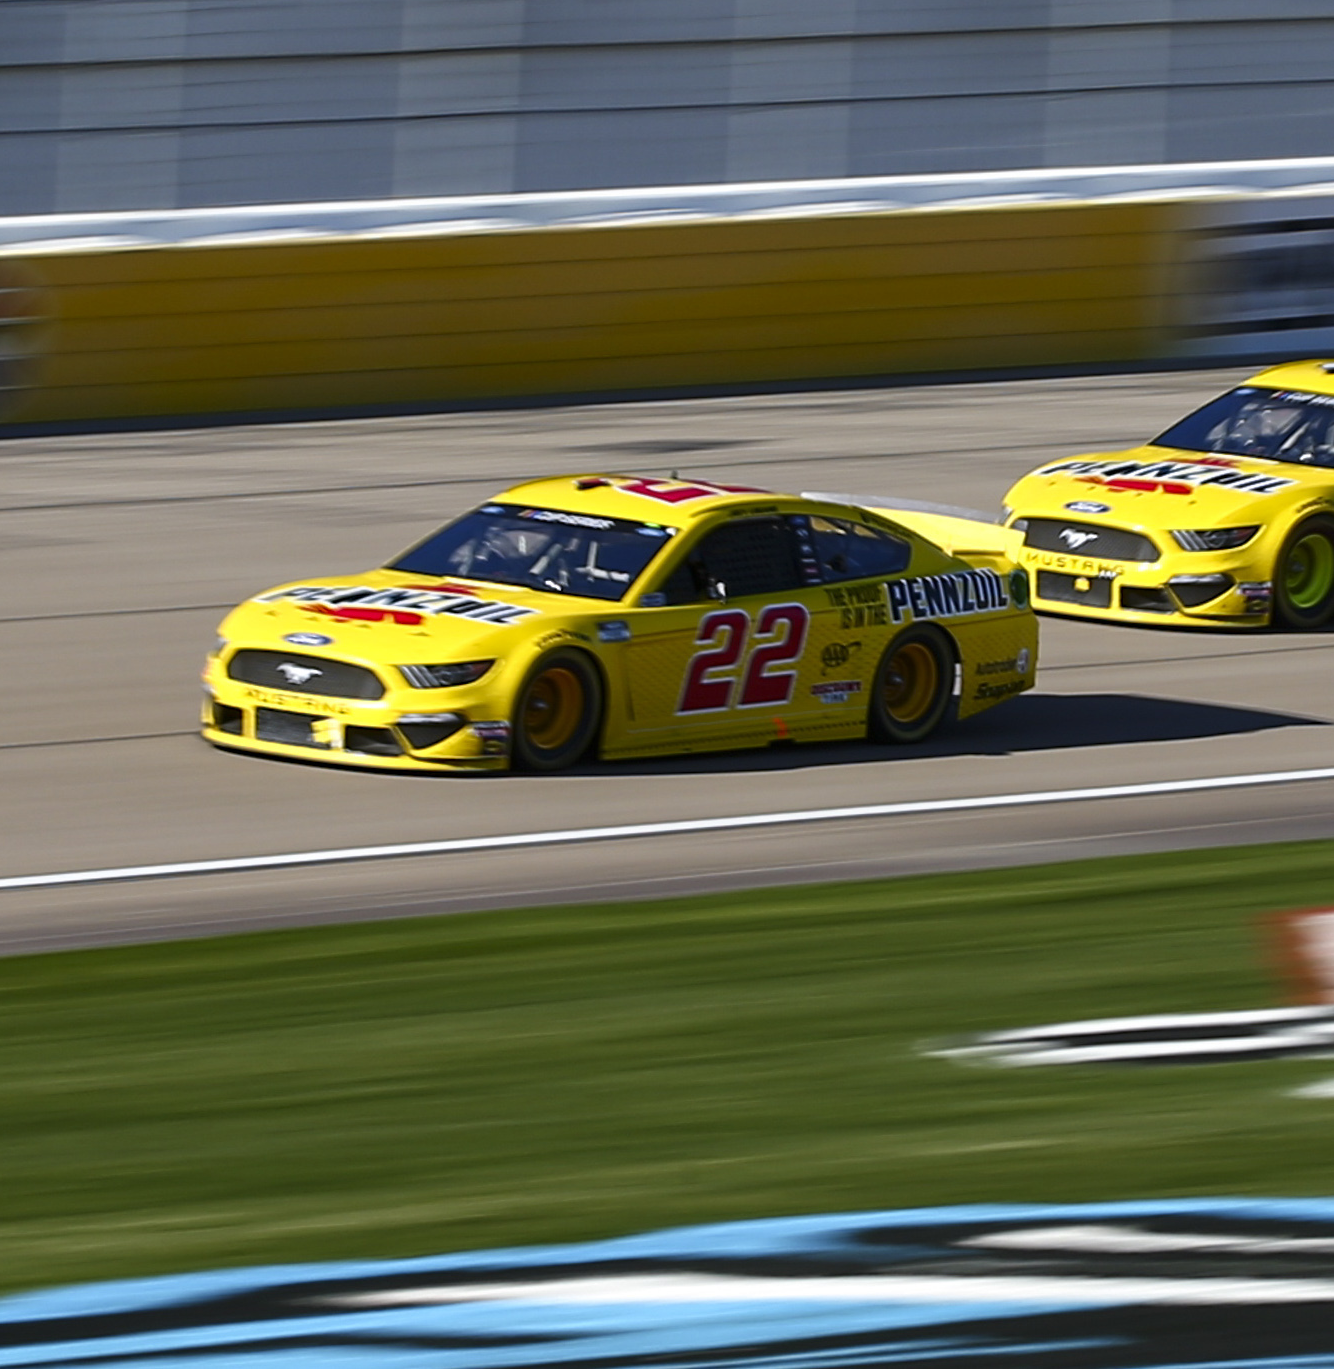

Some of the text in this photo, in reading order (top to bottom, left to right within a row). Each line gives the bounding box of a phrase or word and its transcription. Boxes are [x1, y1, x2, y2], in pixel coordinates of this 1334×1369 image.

[1036, 460, 1297, 494] PENNZOIL
[1025, 551, 1126, 575] MUSTANG
[254, 586, 538, 624] PENNZOIL
[883, 567, 1010, 624] PENNZOIL
[676, 601, 811, 716] 22
